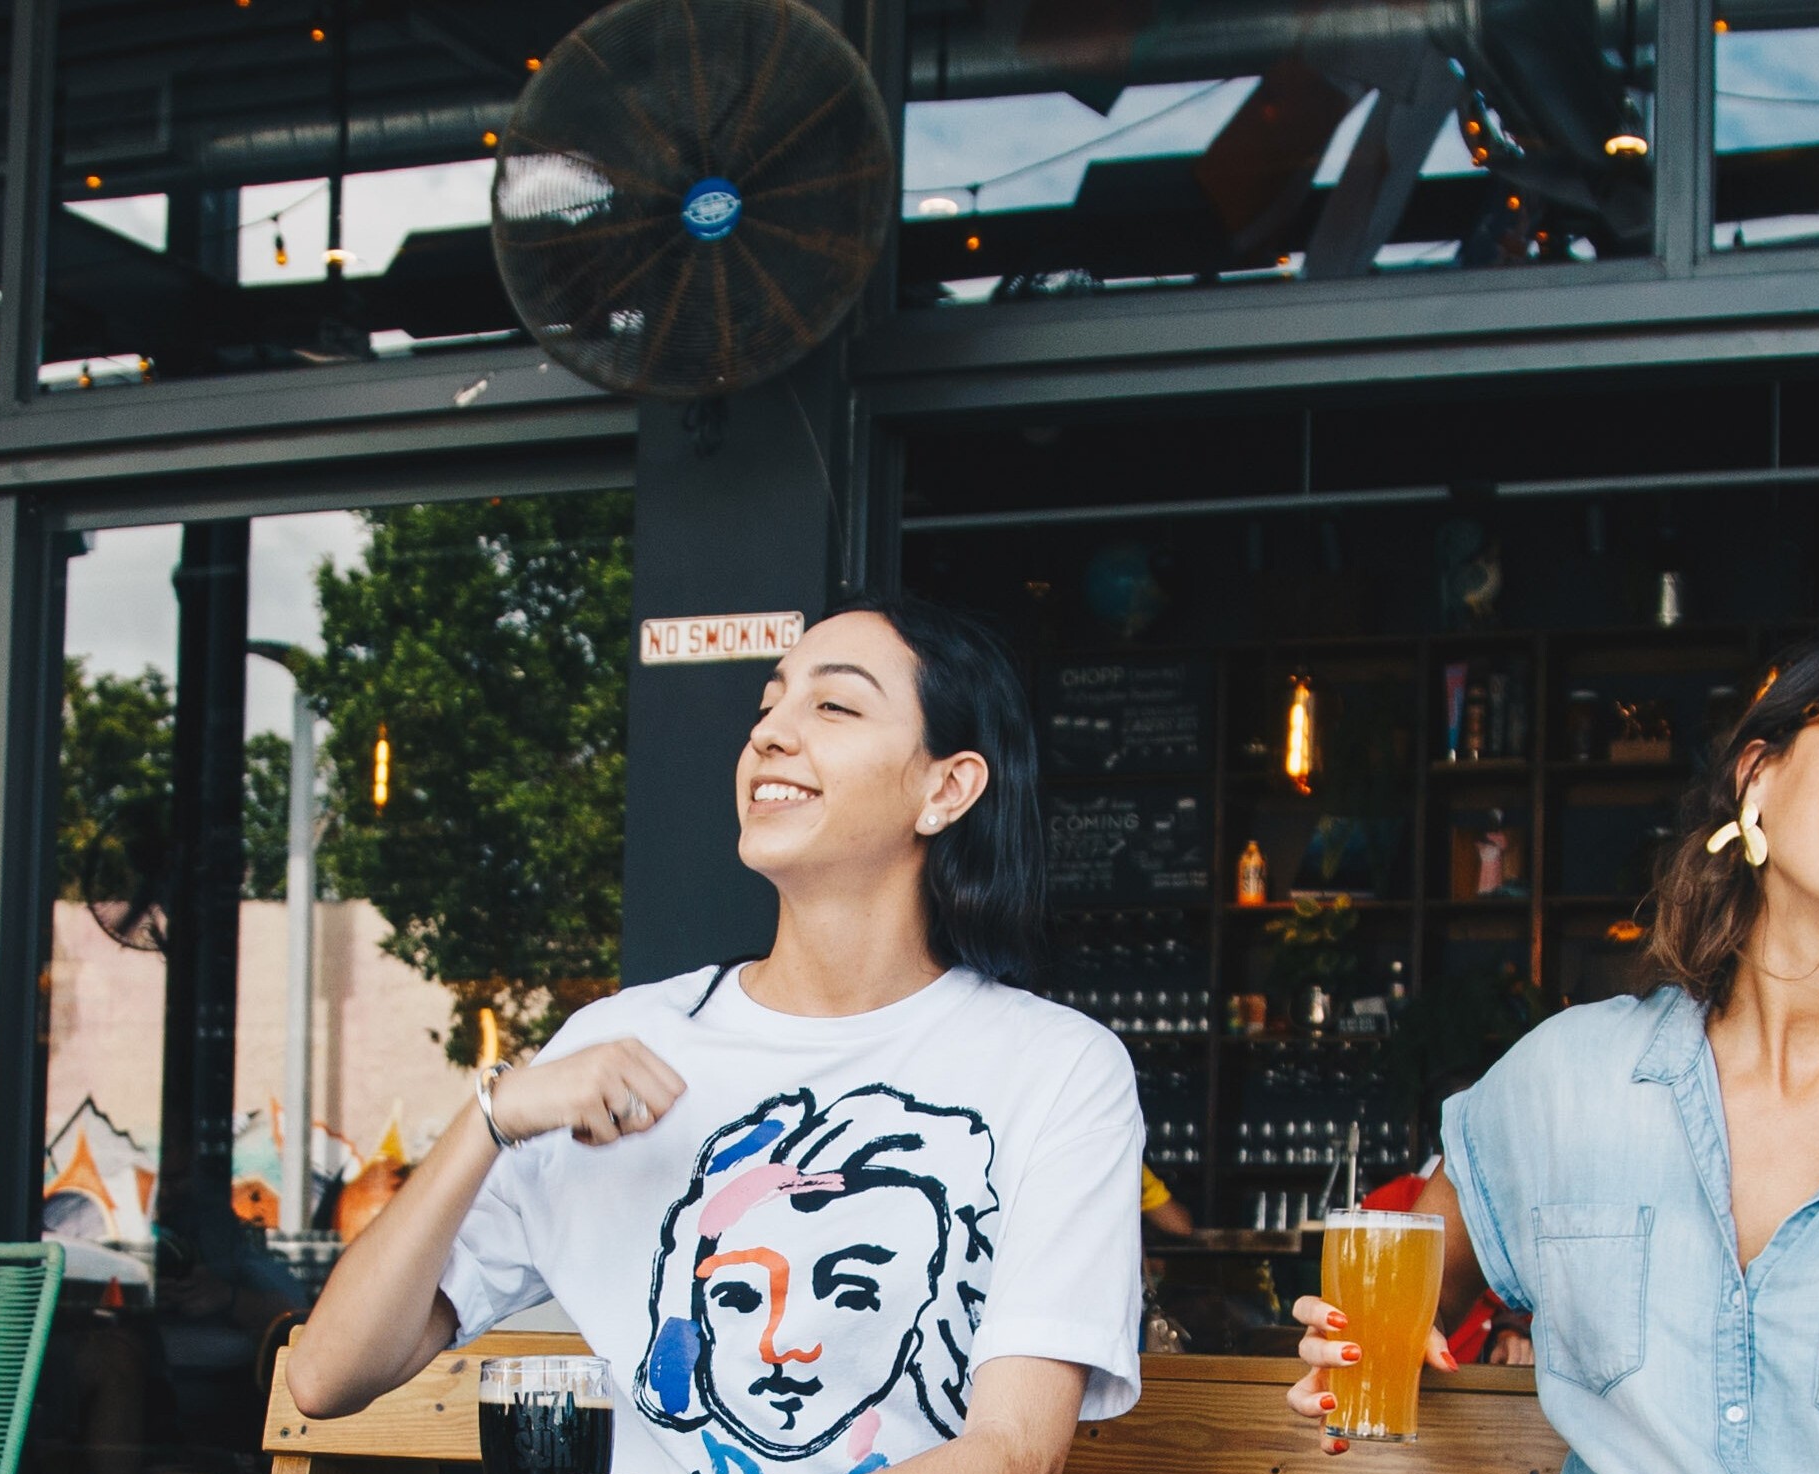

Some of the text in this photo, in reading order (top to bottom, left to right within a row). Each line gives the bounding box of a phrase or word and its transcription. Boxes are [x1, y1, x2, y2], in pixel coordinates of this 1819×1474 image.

[648, 619, 795, 655] NO SMOKING
[1050, 812, 1140, 833] COMING
[516, 1430, 572, 1468] SUR
